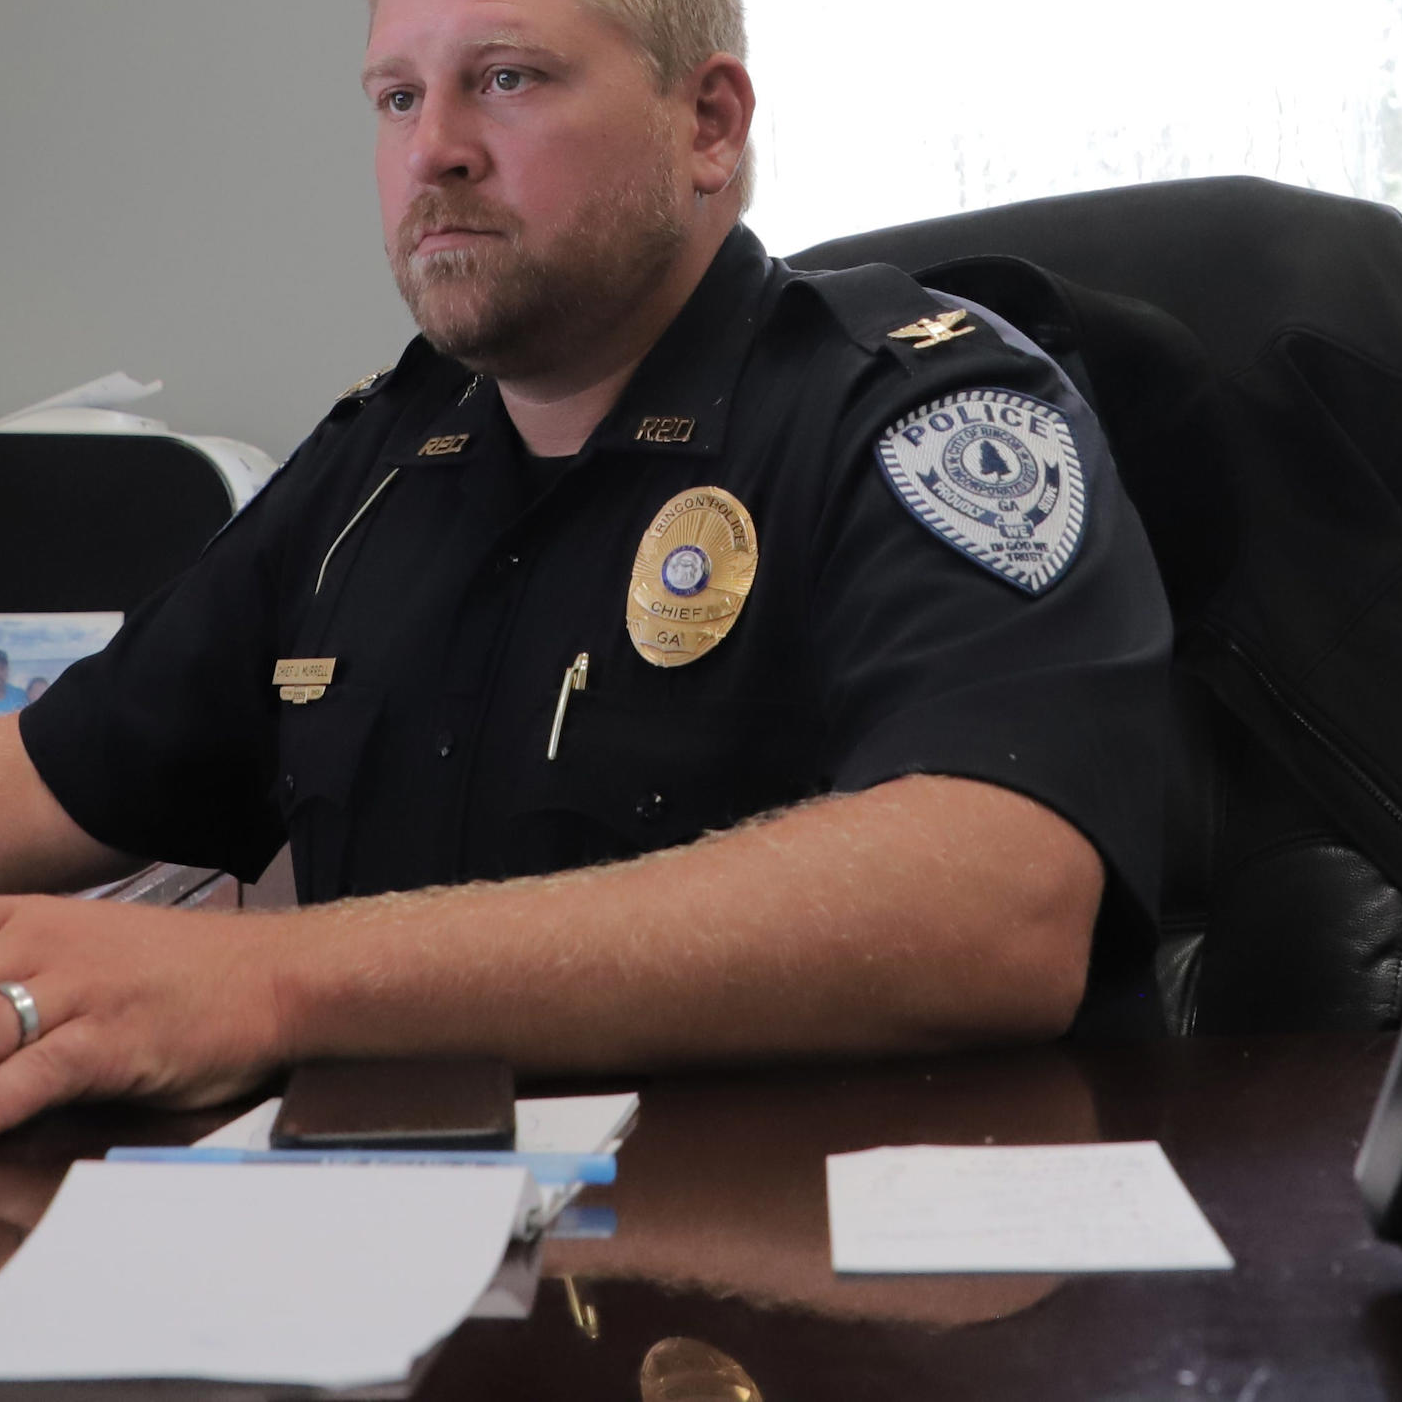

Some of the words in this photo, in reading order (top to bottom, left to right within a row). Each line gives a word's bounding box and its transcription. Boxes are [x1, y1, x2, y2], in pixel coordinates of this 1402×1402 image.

[902, 404, 1050, 447] POLICE
[932, 481, 986, 518] PROUDLY
[1006, 525, 1029, 538] WE
[998, 500, 1020, 512] GA
[655, 497, 705, 534] RINCON
[708, 498, 746, 547] POLICE
[1006, 542, 1031, 552] GOD
[1005, 553, 1044, 563] TRUST
[651, 601, 703, 620] CHIEF
[657, 631, 681, 647] GA
